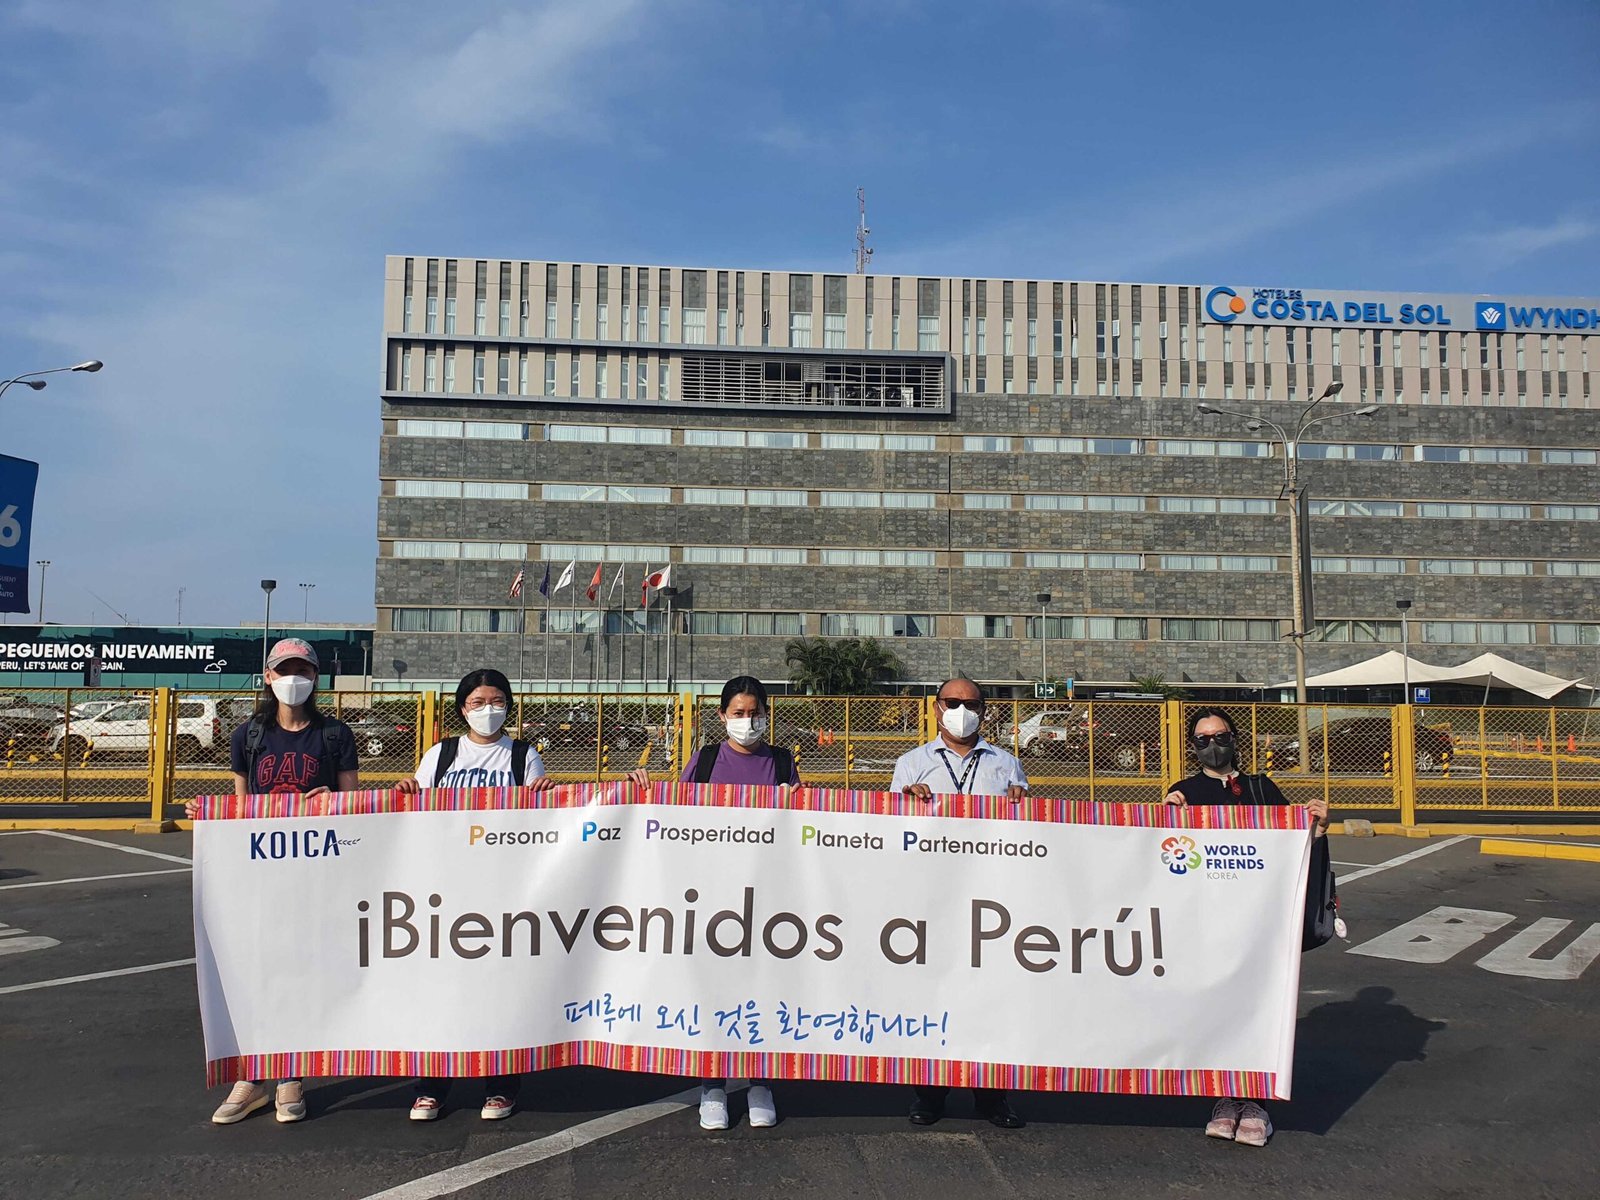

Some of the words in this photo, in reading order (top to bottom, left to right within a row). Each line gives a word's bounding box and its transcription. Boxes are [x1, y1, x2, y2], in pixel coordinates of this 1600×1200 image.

[1252, 287, 1303, 300] HOTELES
[1252, 297, 1338, 321] COSTA
[1343, 302, 1394, 323] DEL
[1399, 304, 1452, 326] SOL
[102, 645, 215, 660] NUEVAMENTE
[0, 661, 21, 671] ERU,
[24, 661, 45, 670] LET'S
[47, 662, 68, 670] TAKE
[258, 752, 319, 786] GAP
[251, 829, 338, 860] KOICA
[469, 825, 559, 846] Persona
[583, 822, 621, 842] Paz
[646, 819, 775, 847] Prosperidad
[802, 825, 883, 850] Planeta
[904, 831, 1048, 859] Partenariado
[1204, 844, 1257, 857] WORLD
[1206, 858, 1265, 870] FRIENDS
[1206, 871, 1239, 880] KOREA
[358, 886, 843, 968] ¡Bienvenidos
[880, 918, 927, 965] a
[971, 899, 1166, 978] Perú!
[563, 993, 641, 1033] 페루에
[656, 1003, 701, 1037] 오신
[714, 1000, 765, 1045] 것을
[776, 1001, 949, 1047] 환영합니다!
